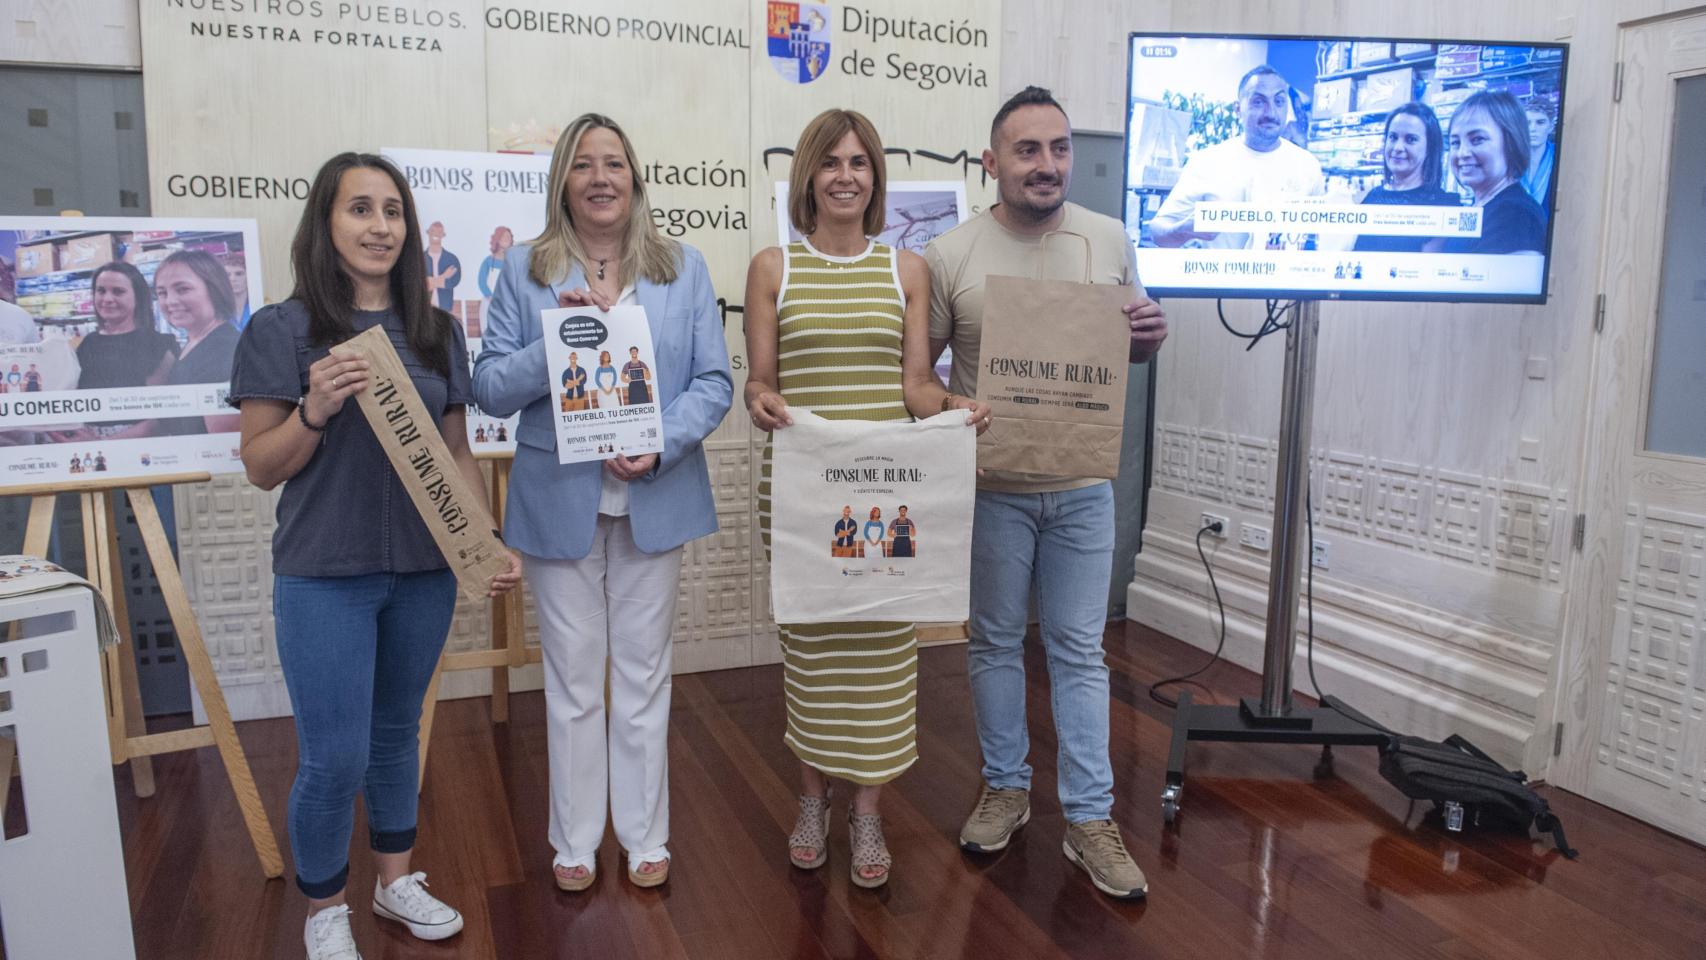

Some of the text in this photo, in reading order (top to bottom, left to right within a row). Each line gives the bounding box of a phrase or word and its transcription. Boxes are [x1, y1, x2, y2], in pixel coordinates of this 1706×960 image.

[339, 3, 467, 30] PUEBLOS.
[485, 7, 750, 49] GOBIERNO PROVINCIAL
[843, 6, 988, 48] Diputación
[190, 22, 443, 52] NUESTRA FORTALEZA
[841, 49, 988, 91] de Segovia
[168, 174, 311, 200] GOBIERNO
[405, 165, 473, 192] BONOS
[651, 204, 748, 237] egovia
[1200, 209, 1218, 221] TU
[1220, 210, 1276, 223] PUEBLO,
[1281, 210, 1298, 223] TU
[1300, 211, 1368, 224] COMERCIO
[1184, 260, 1219, 274] BONOS
[1224, 261, 1276, 275] COMERCIO
[990, 357, 1112, 386] CONSUME RURAL
[14, 398, 101, 416] COMERCIO
[562, 406, 655, 423] TU PUEBLO, TU COMERCIO
[374, 376, 469, 534] CONSUME RURAL
[825, 468, 922, 482] CONSUME RURAL
